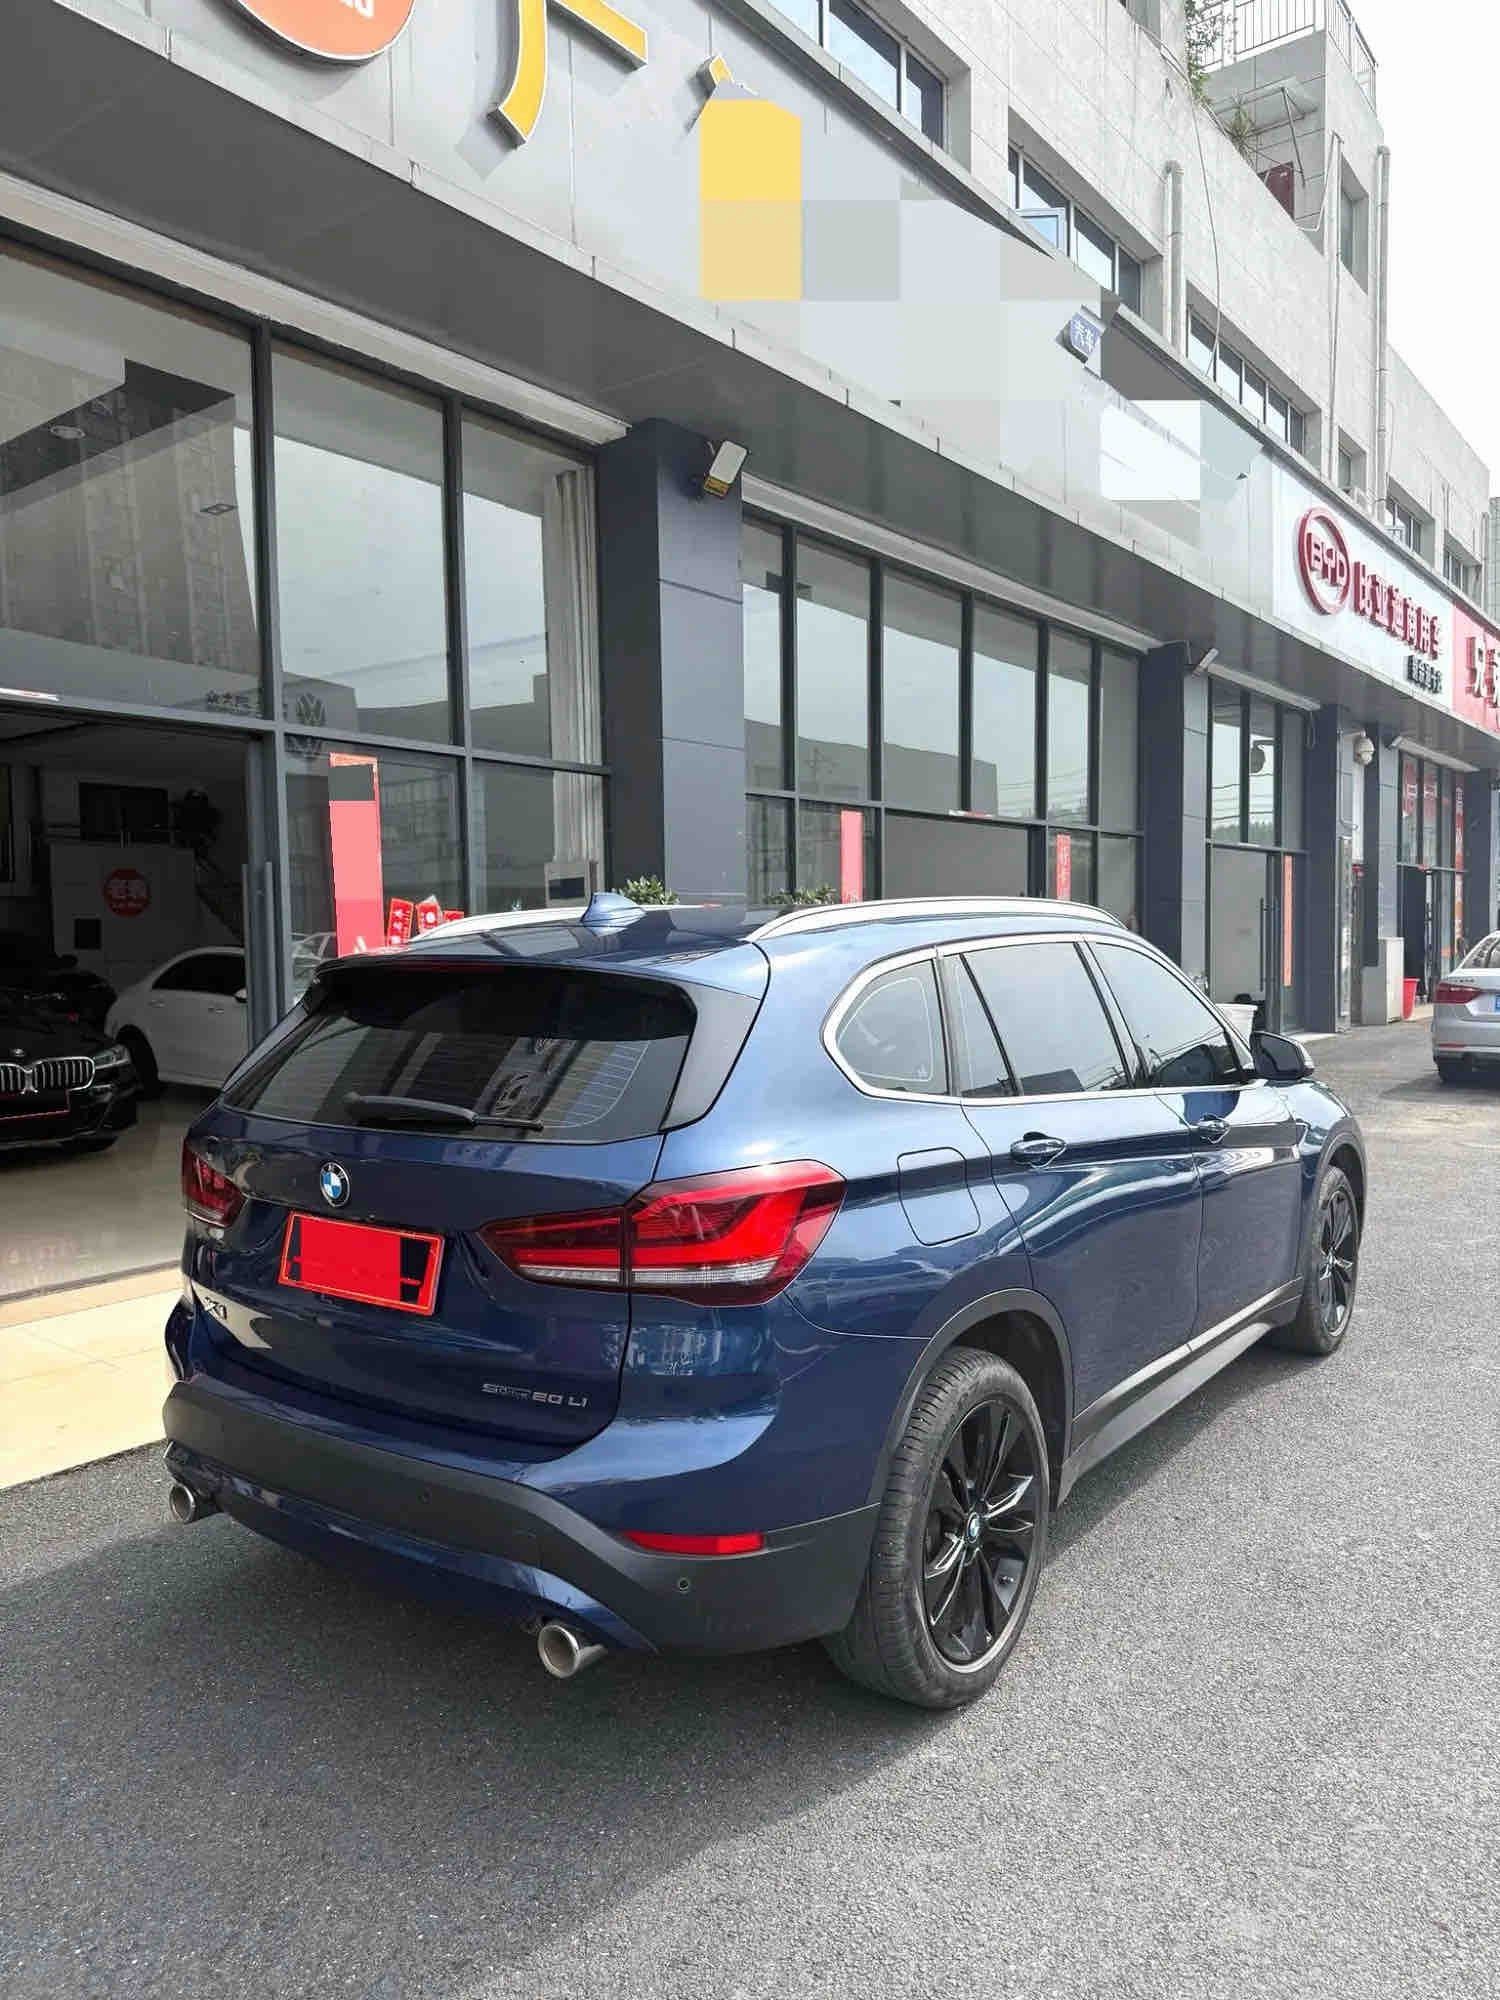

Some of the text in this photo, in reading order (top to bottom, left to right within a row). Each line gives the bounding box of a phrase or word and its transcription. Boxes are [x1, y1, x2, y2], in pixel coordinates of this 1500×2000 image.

[1353, 560, 1440, 660] 比亚迪商用车
